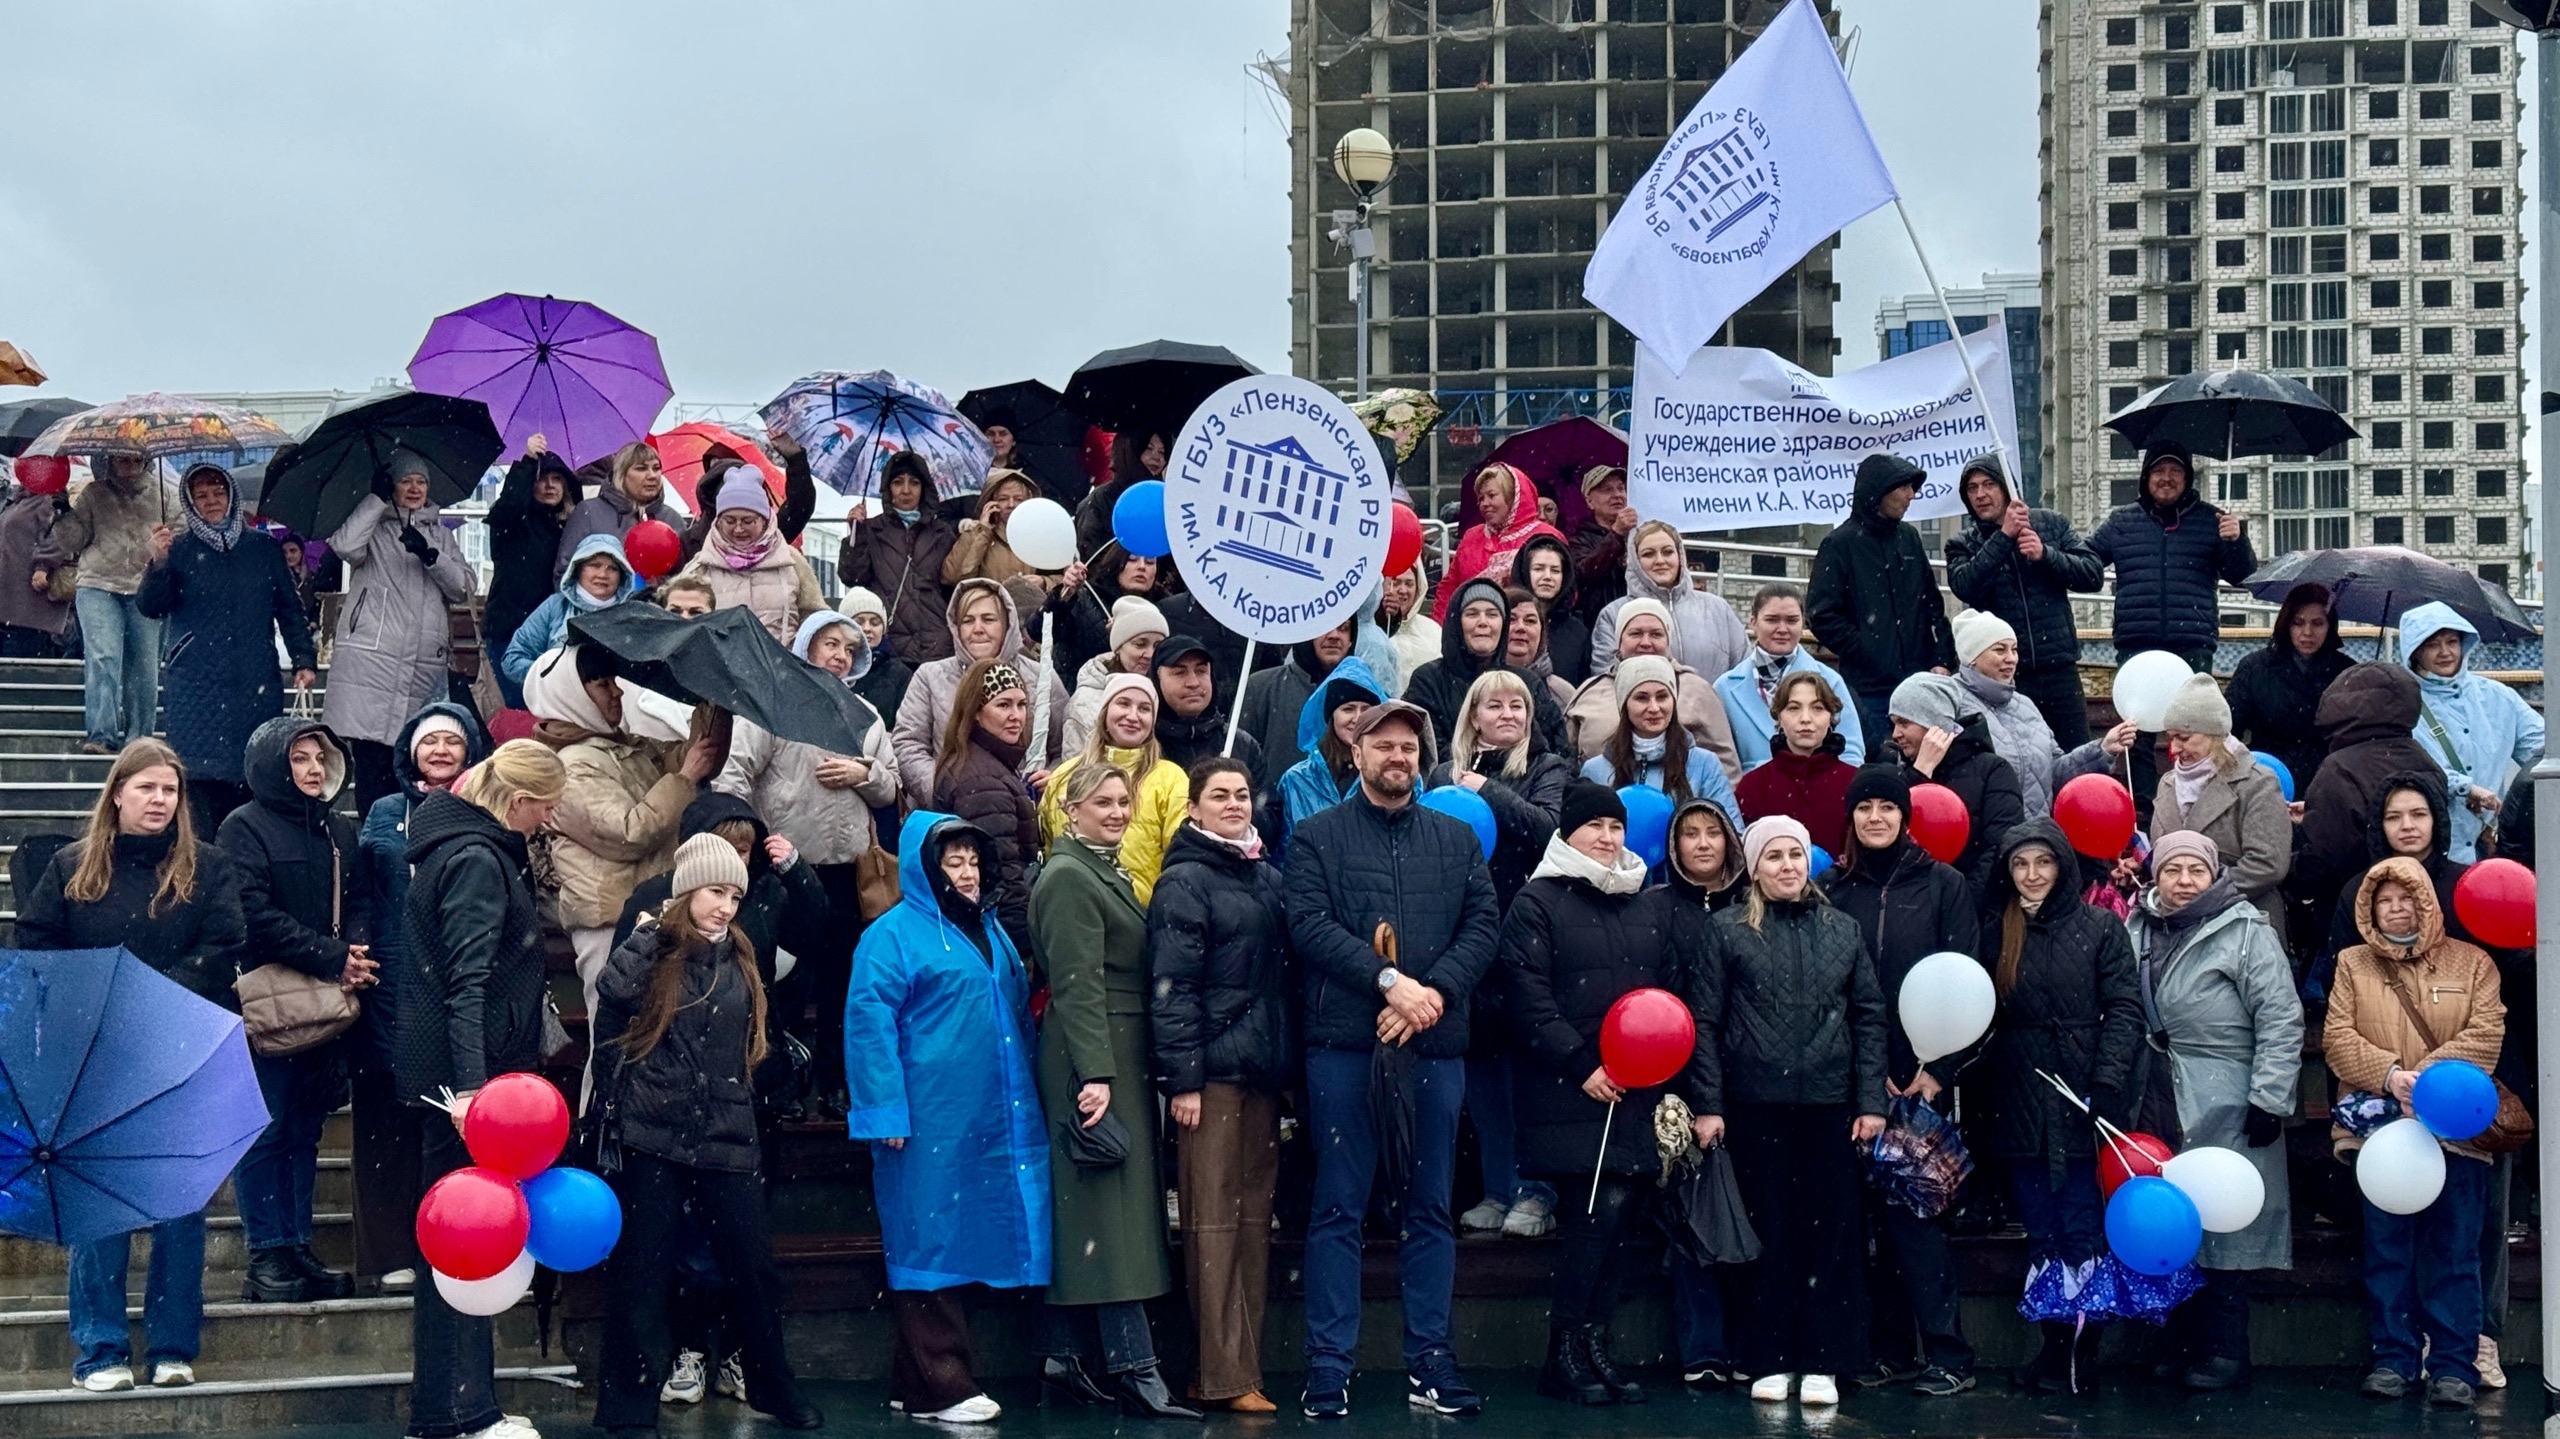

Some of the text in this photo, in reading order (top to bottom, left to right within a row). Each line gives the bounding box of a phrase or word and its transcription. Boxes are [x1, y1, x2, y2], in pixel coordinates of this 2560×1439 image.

[1654, 387, 1973, 429] Государственное бюджетное
[1644, 414, 1986, 458] учреждение здравоохранения
[1181, 388, 1380, 539] ГБУЗ «Пензенская РБ
[1633, 459, 1767, 485] «Пензенская
[1683, 496, 1750, 514] имени
[1757, 491, 1799, 513] К.А.
[1181, 502, 1368, 628] им. К.А. Карагизова»
